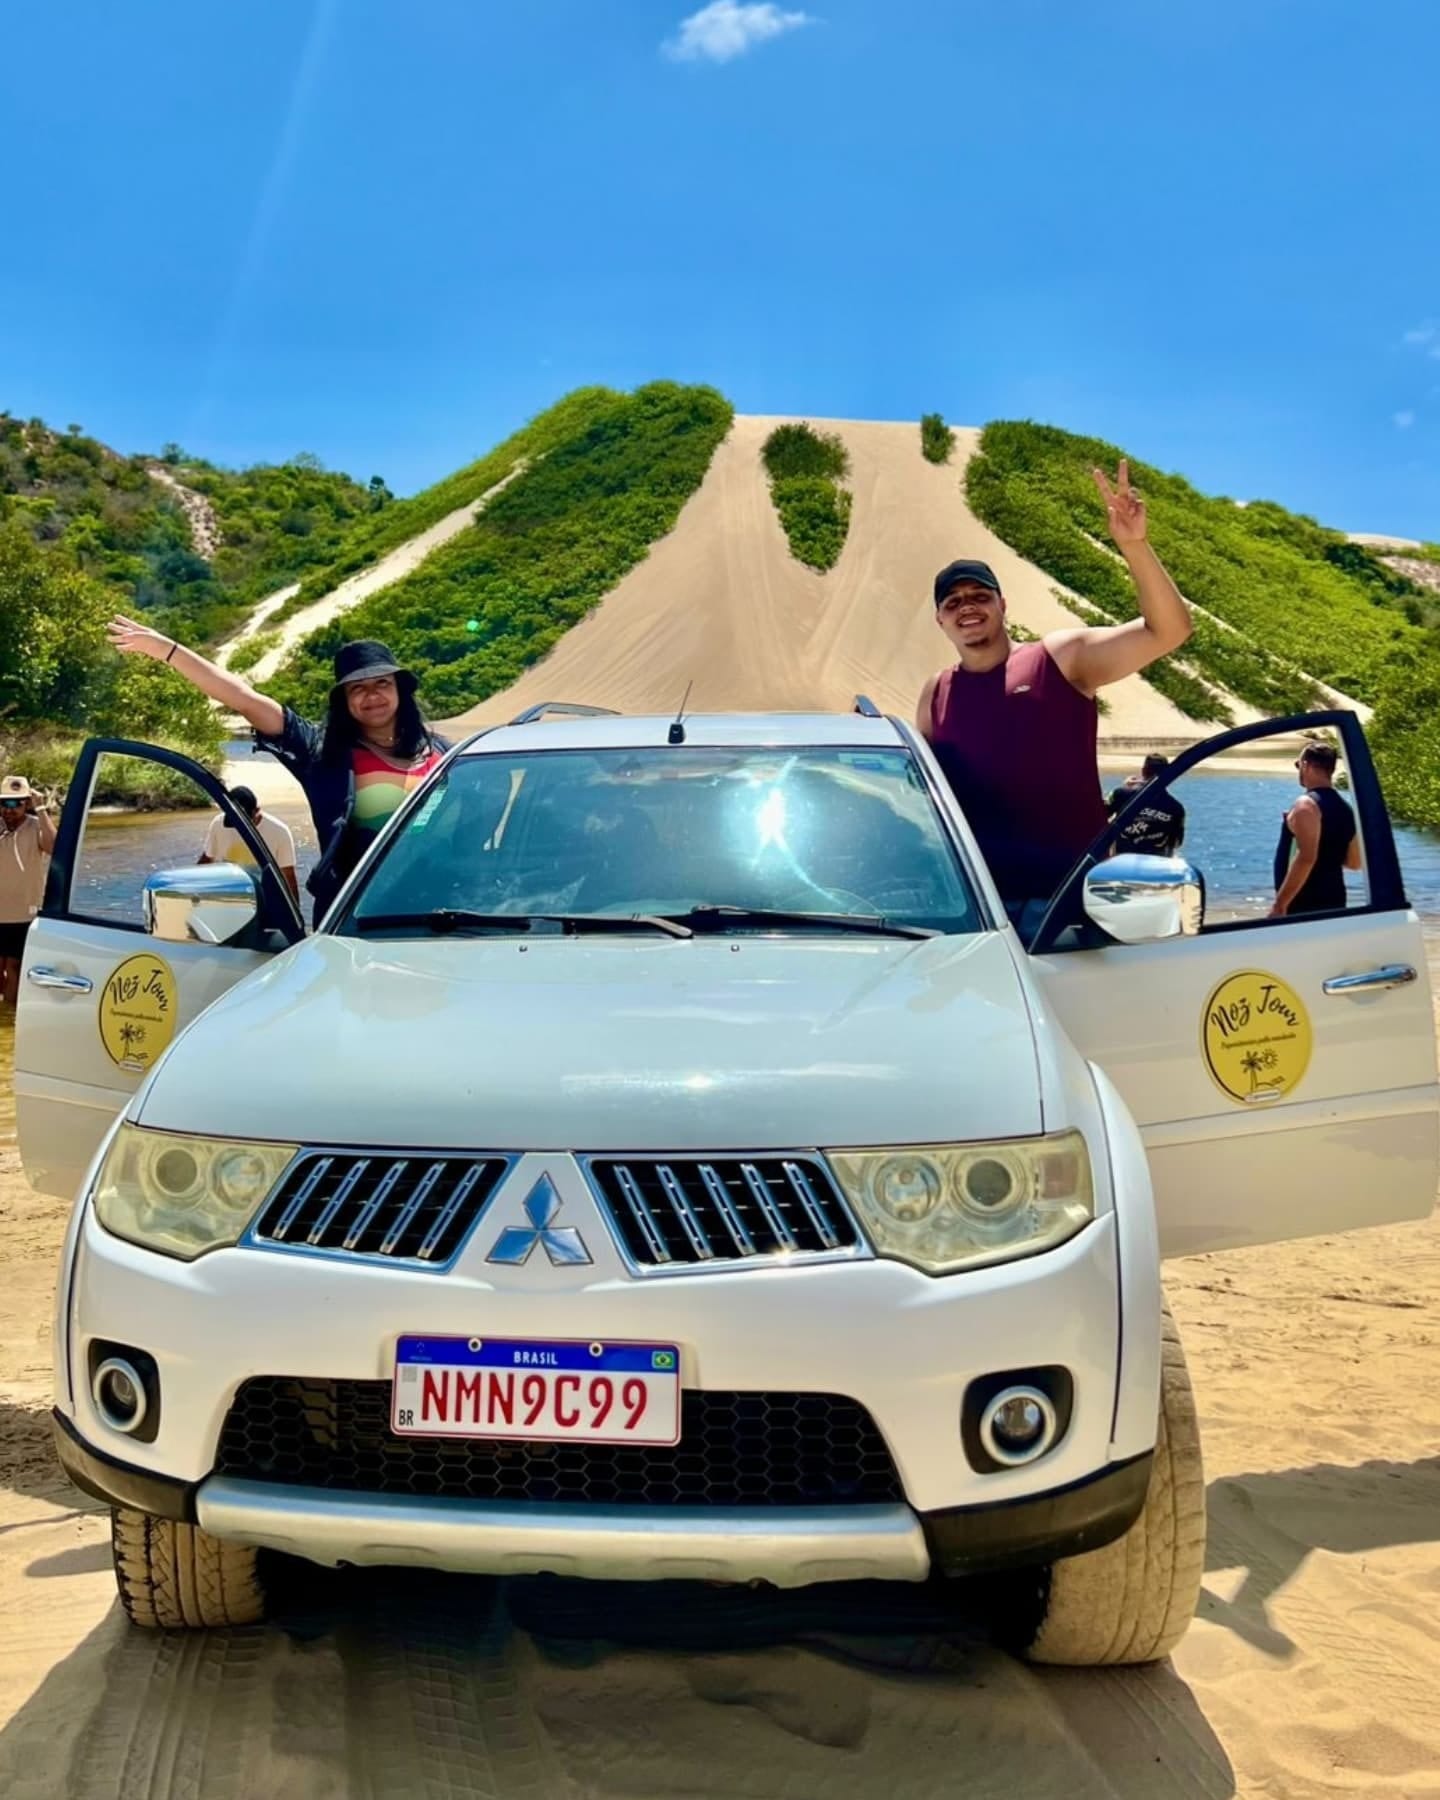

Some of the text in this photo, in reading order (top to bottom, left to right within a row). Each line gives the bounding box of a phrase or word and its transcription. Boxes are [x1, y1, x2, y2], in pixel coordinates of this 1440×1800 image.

[142, 969, 168, 1012] Tour
[1256, 984, 1300, 1027] Tour
[513, 1351, 558, 1365] BRASIL
[399, 1409, 414, 1426] BR
[421, 1369, 648, 1430] NMN9C99
